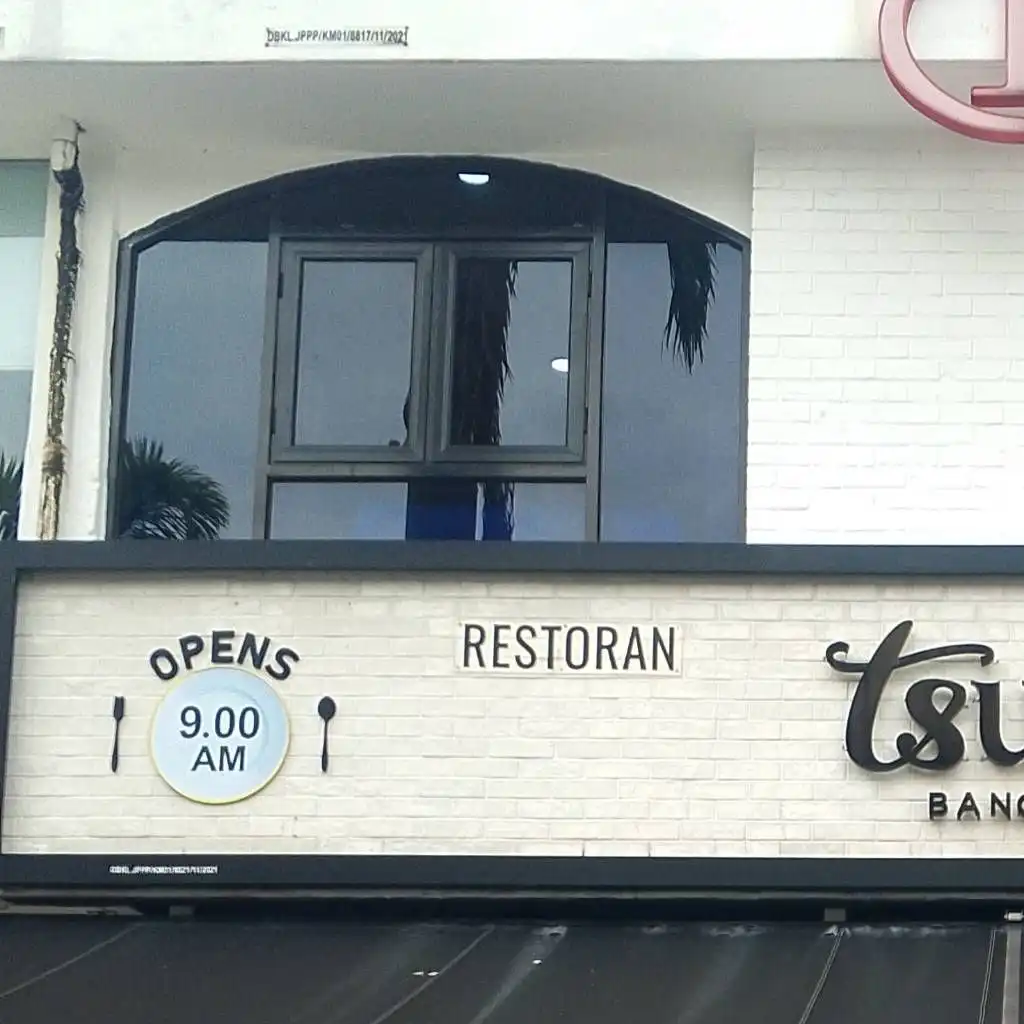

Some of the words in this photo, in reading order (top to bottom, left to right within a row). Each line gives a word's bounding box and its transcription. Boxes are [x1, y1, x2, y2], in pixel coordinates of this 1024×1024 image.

[150, 630, 299, 681] OPENS
[463, 623, 675, 671] RESTORAN
[179, 705, 261, 739] 9.00
[191, 745, 246, 772] AM
